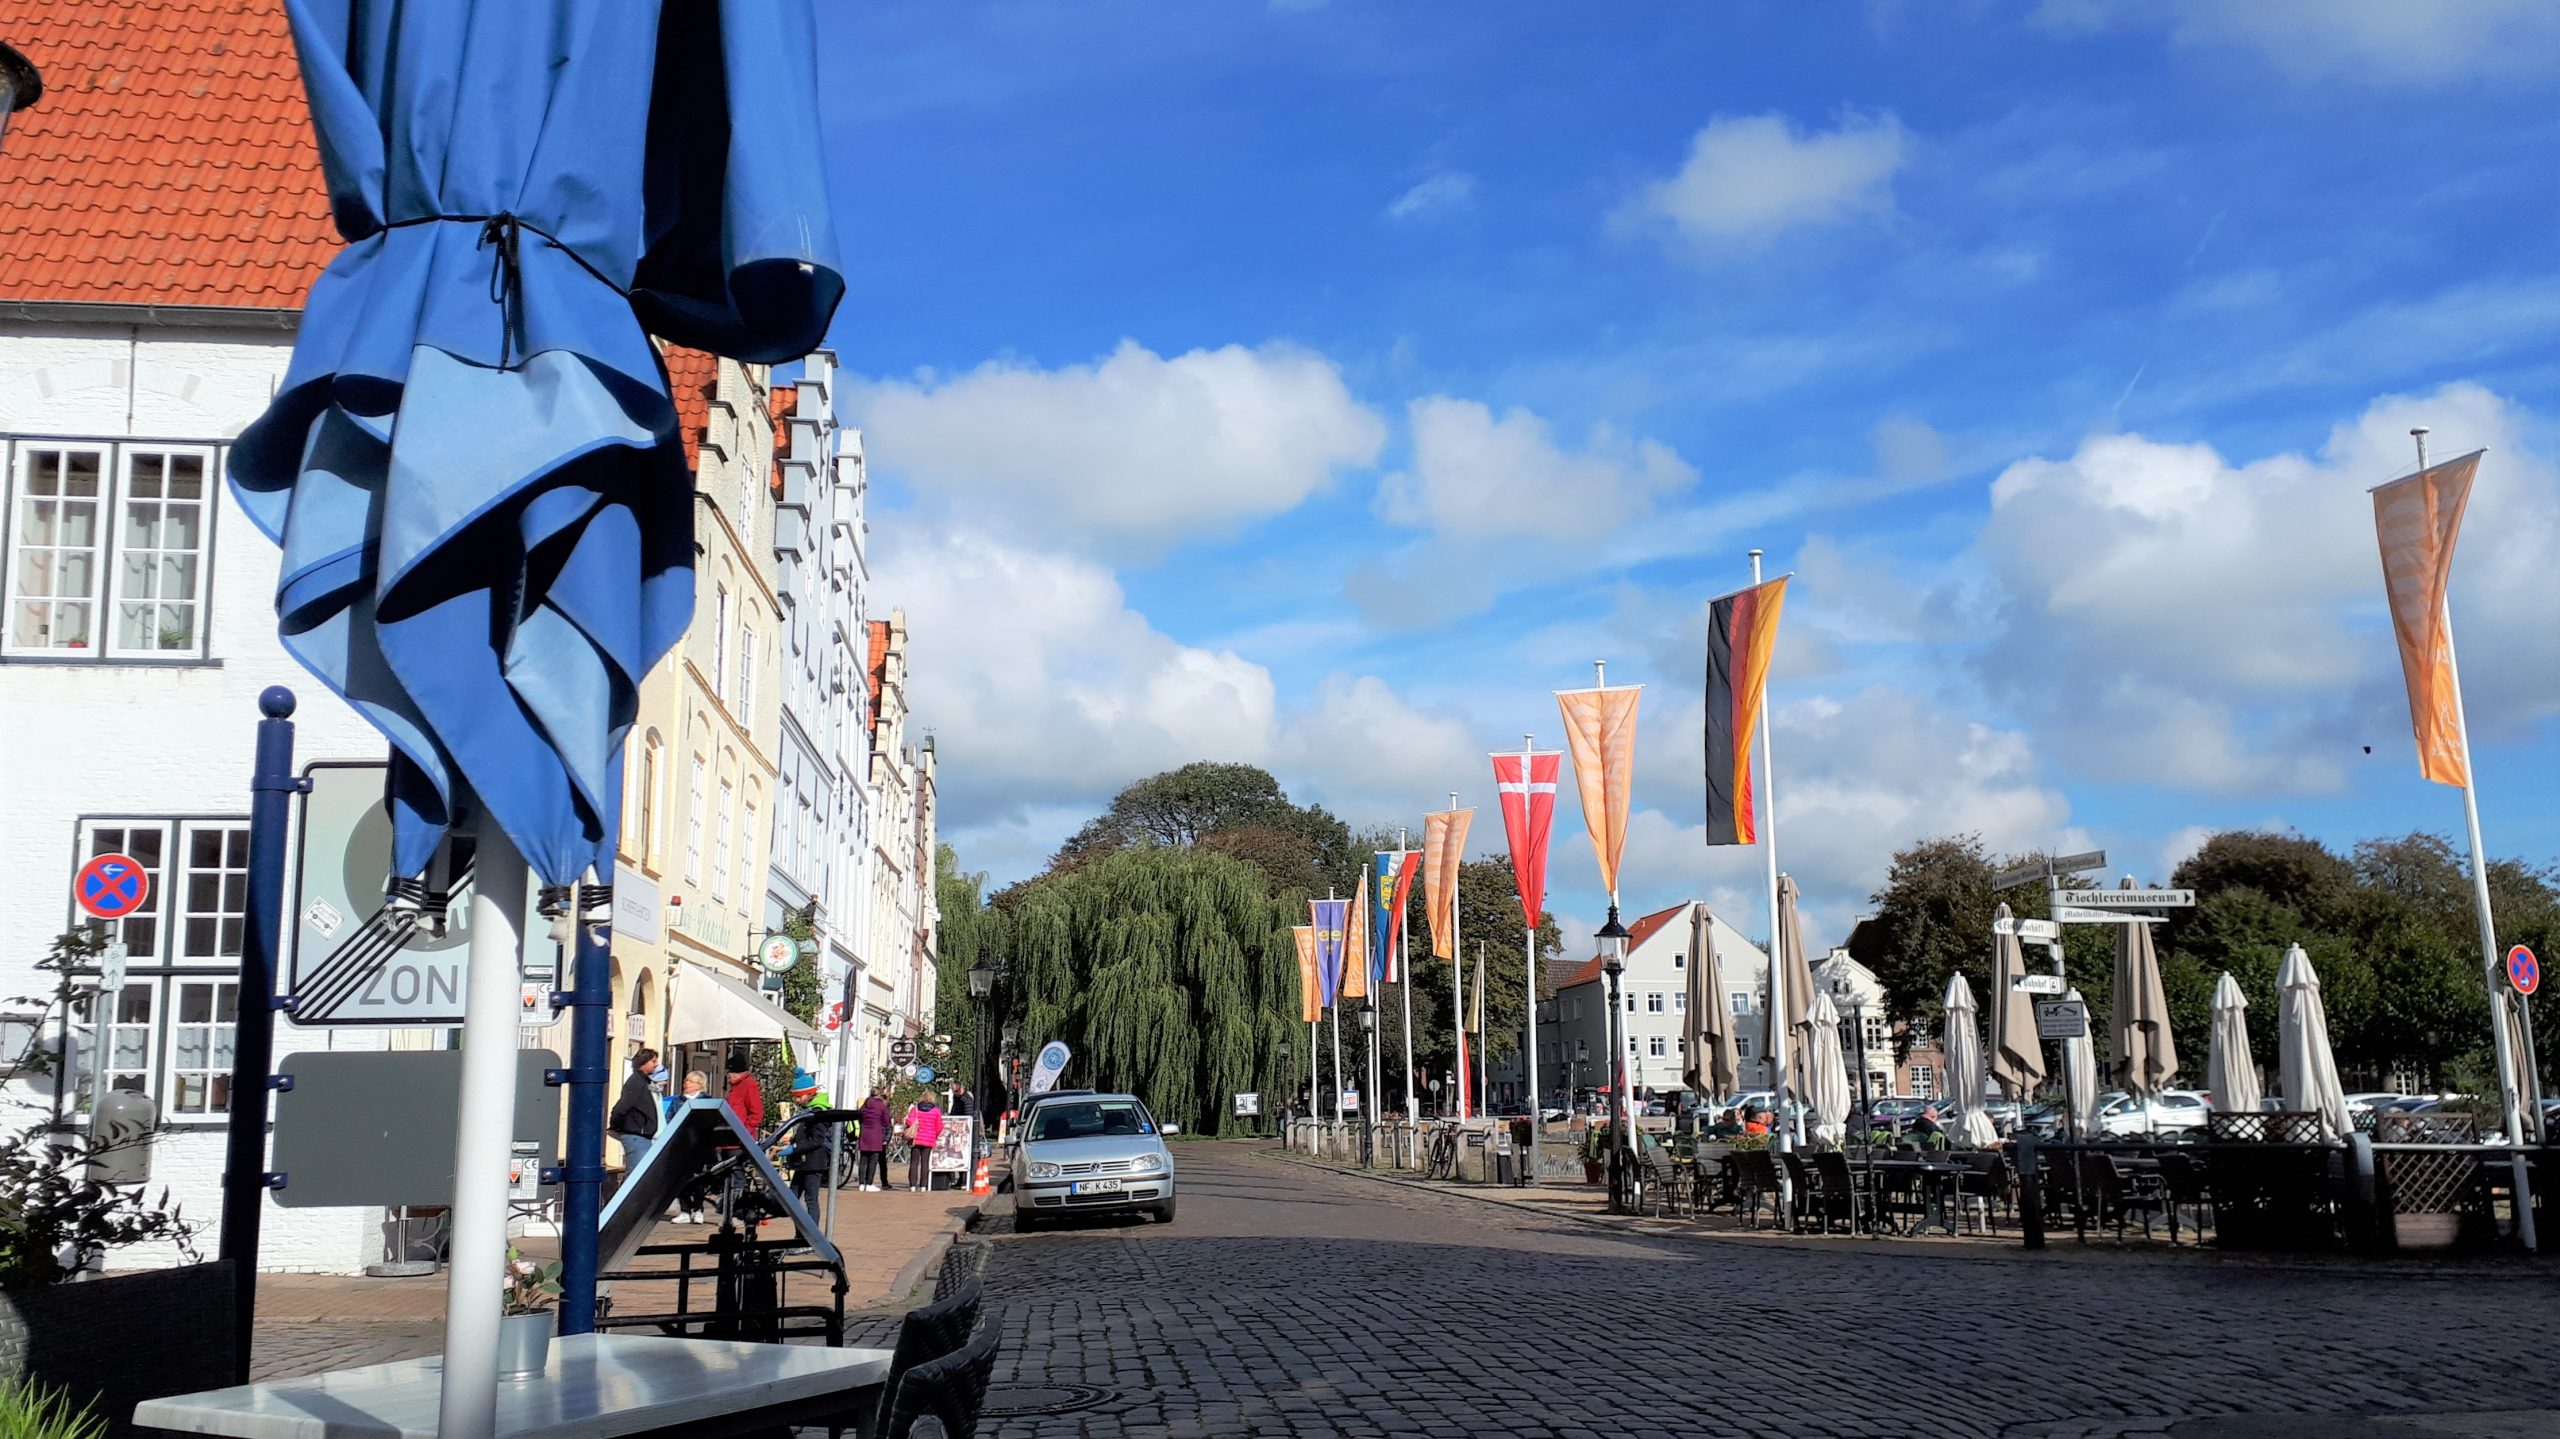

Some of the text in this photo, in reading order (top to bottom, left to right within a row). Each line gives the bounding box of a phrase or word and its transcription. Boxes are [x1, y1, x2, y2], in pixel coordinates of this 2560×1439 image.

[2065, 891, 2177, 905] Tischlereimuseum
[359, 965, 459, 1006] ZON
[1079, 1180, 1119, 1192] NF K 435
